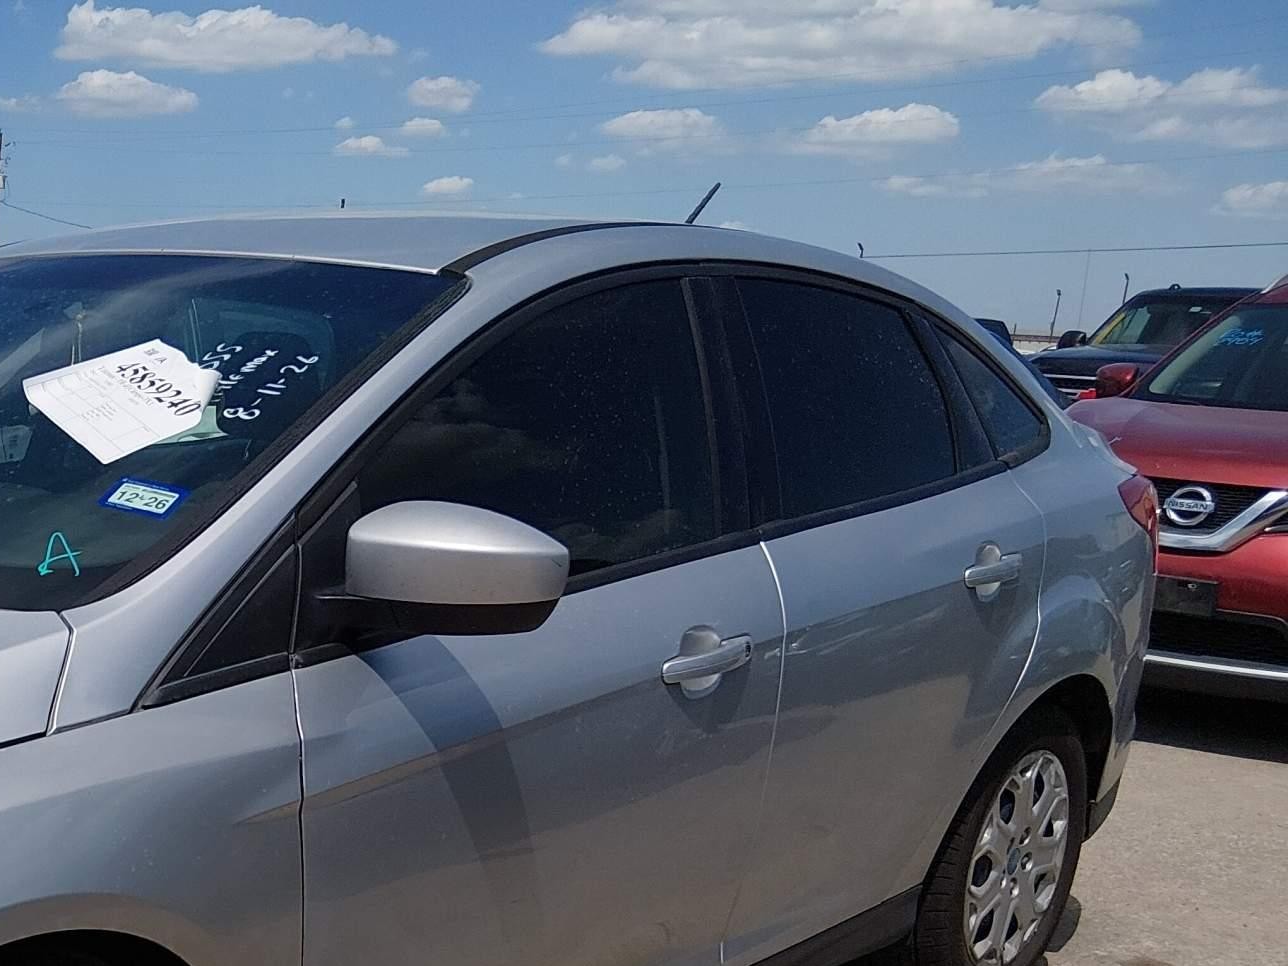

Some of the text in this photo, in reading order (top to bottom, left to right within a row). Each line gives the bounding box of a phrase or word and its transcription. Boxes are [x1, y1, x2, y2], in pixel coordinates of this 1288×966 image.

[116, 363, 201, 416] 45859240
[223, 354, 319, 420] 8-11-26
[143, 497, 169, 509] 26
[1167, 499, 1208, 510] NISSAN
[37, 532, 82, 577] A
